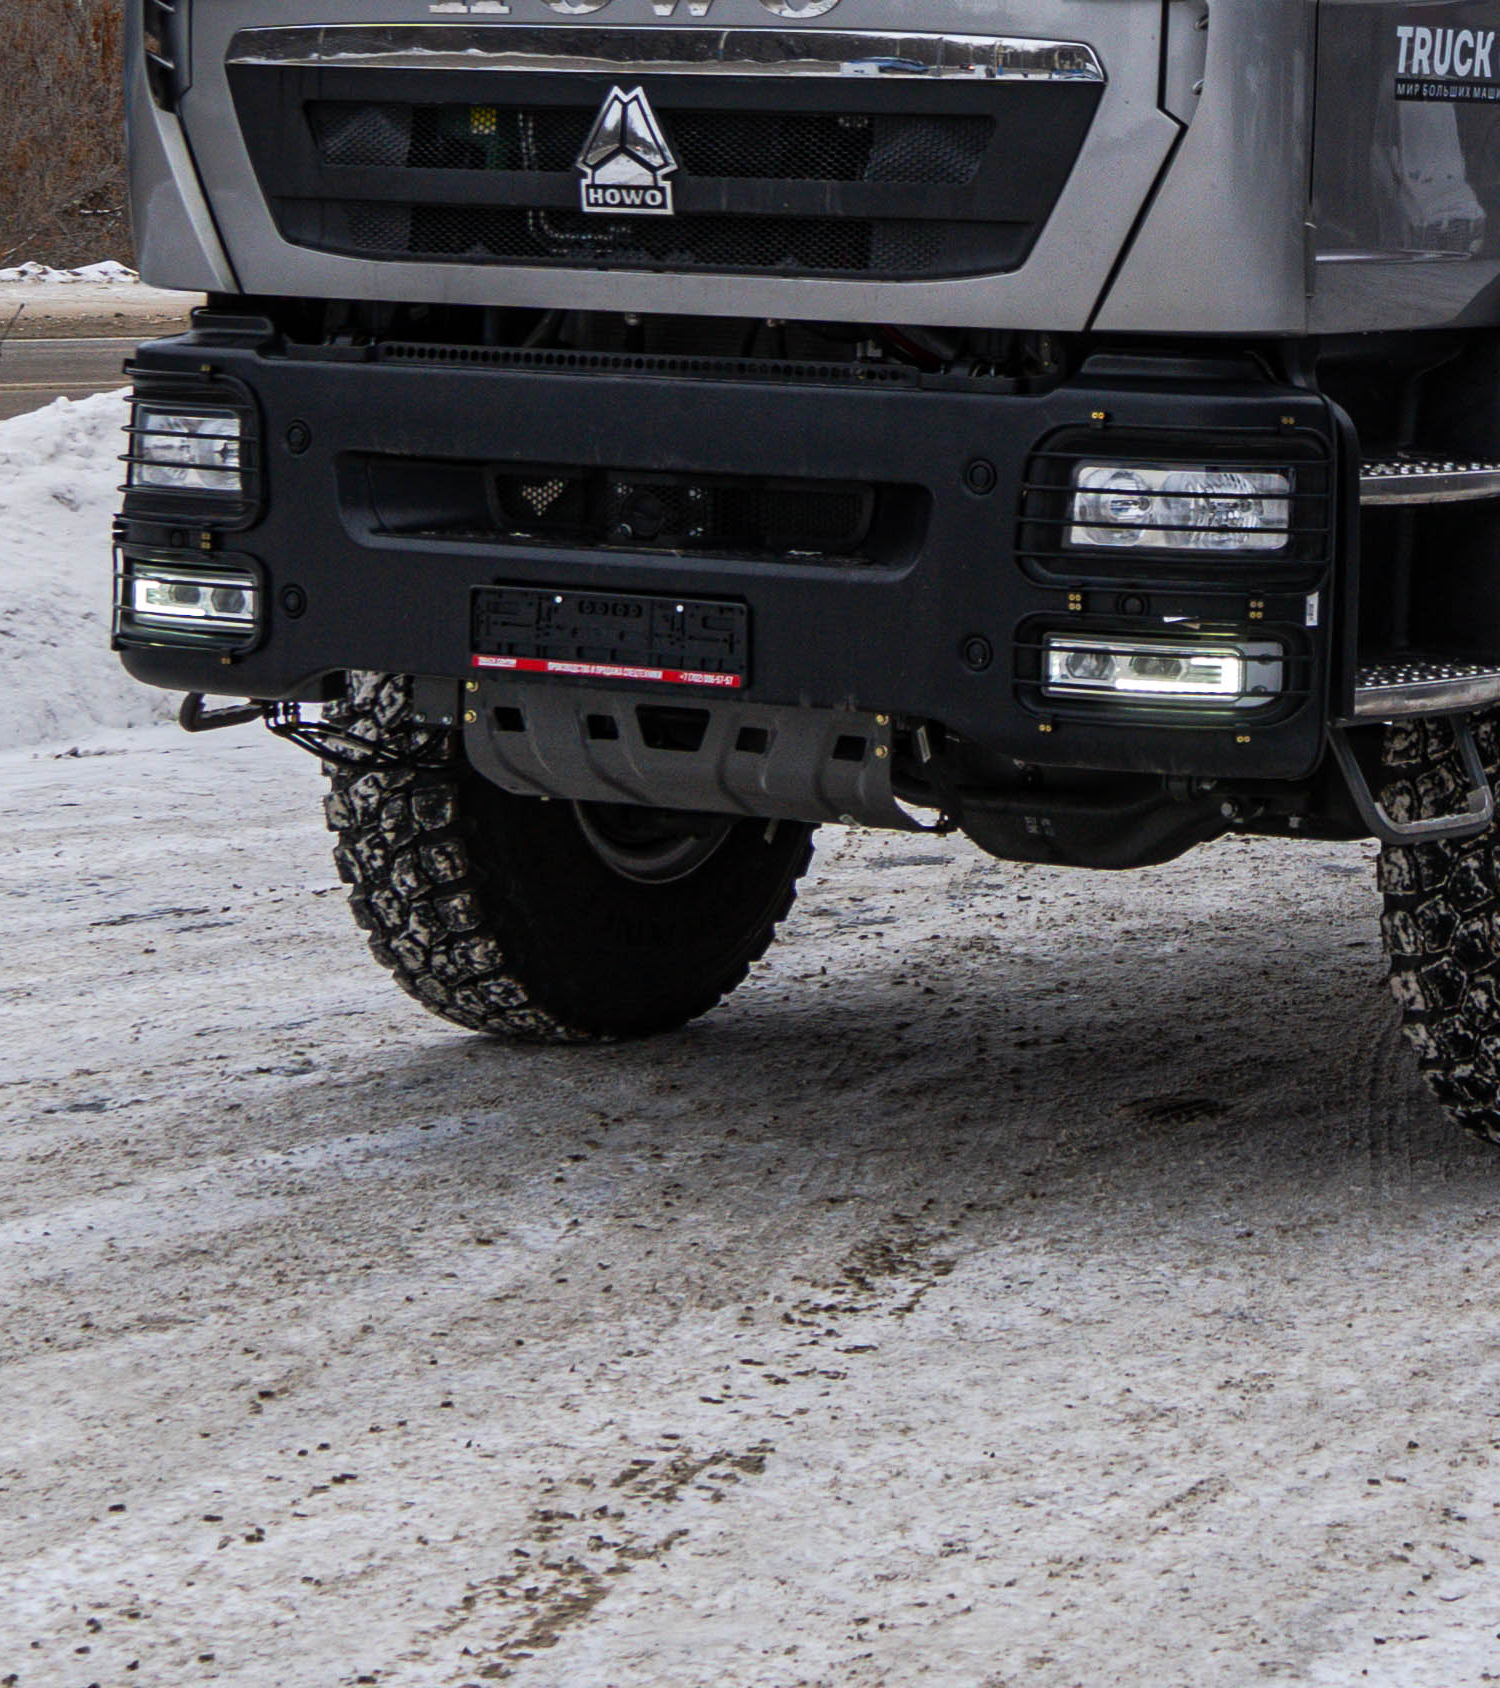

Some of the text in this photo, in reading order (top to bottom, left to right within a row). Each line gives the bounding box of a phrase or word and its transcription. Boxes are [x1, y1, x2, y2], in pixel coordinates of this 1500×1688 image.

[1396, 25, 1495, 78] TRUCK
[1396, 83, 1420, 97] МИР
[1422, 84, 1471, 98] БОЛЬШИХ
[588, 188, 663, 206] HOWO
